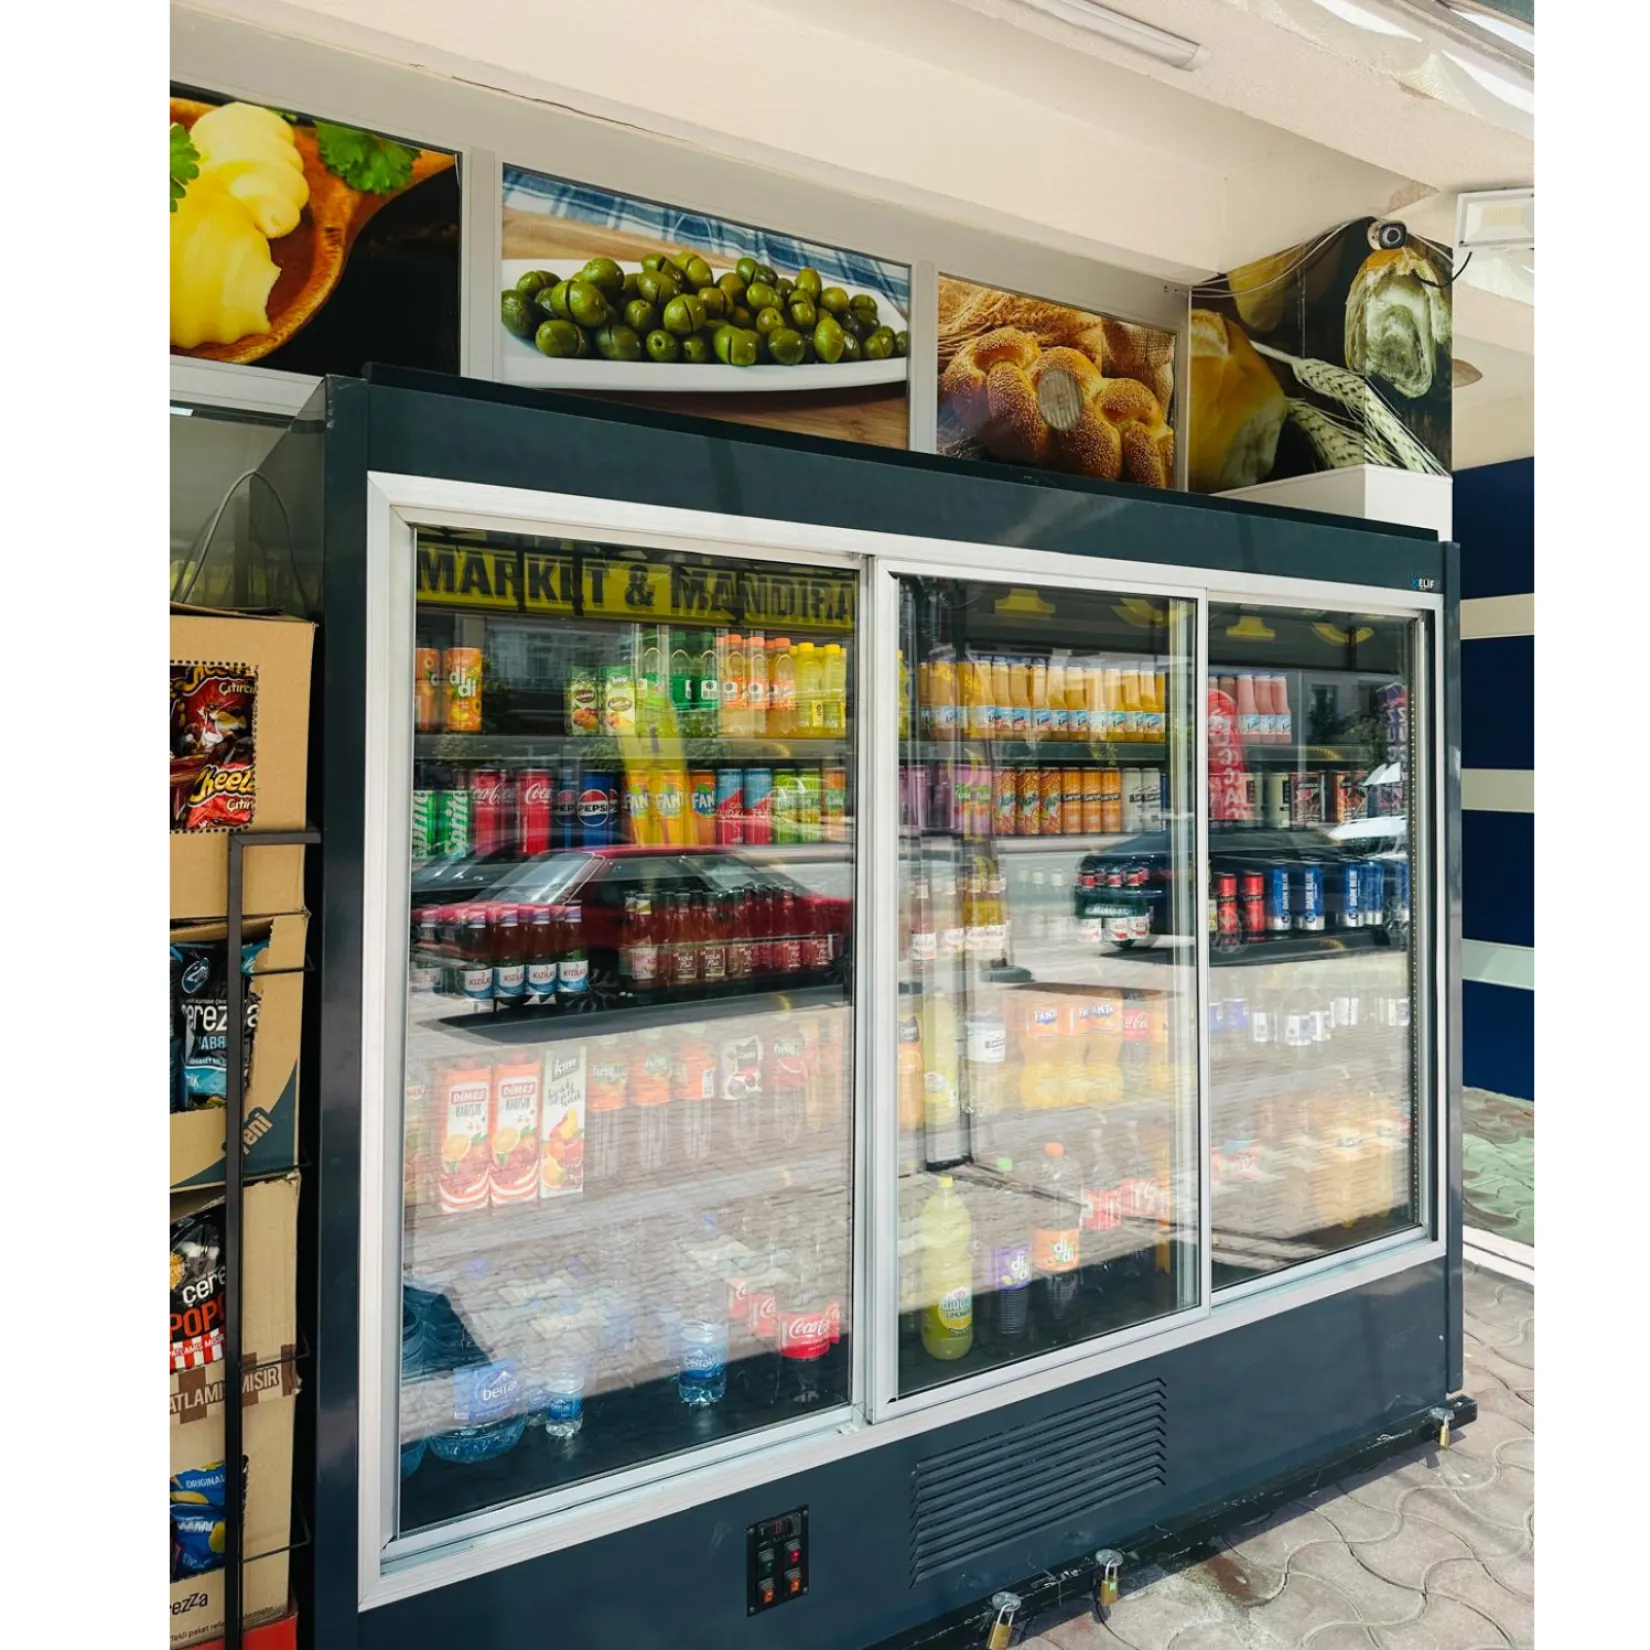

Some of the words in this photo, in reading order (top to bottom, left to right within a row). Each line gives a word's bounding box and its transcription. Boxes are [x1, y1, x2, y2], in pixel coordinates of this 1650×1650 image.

[624, 564, 655, 613] &
[170, 1382, 225, 1413] ATLAMI
[170, 1592, 208, 1615] ezza
